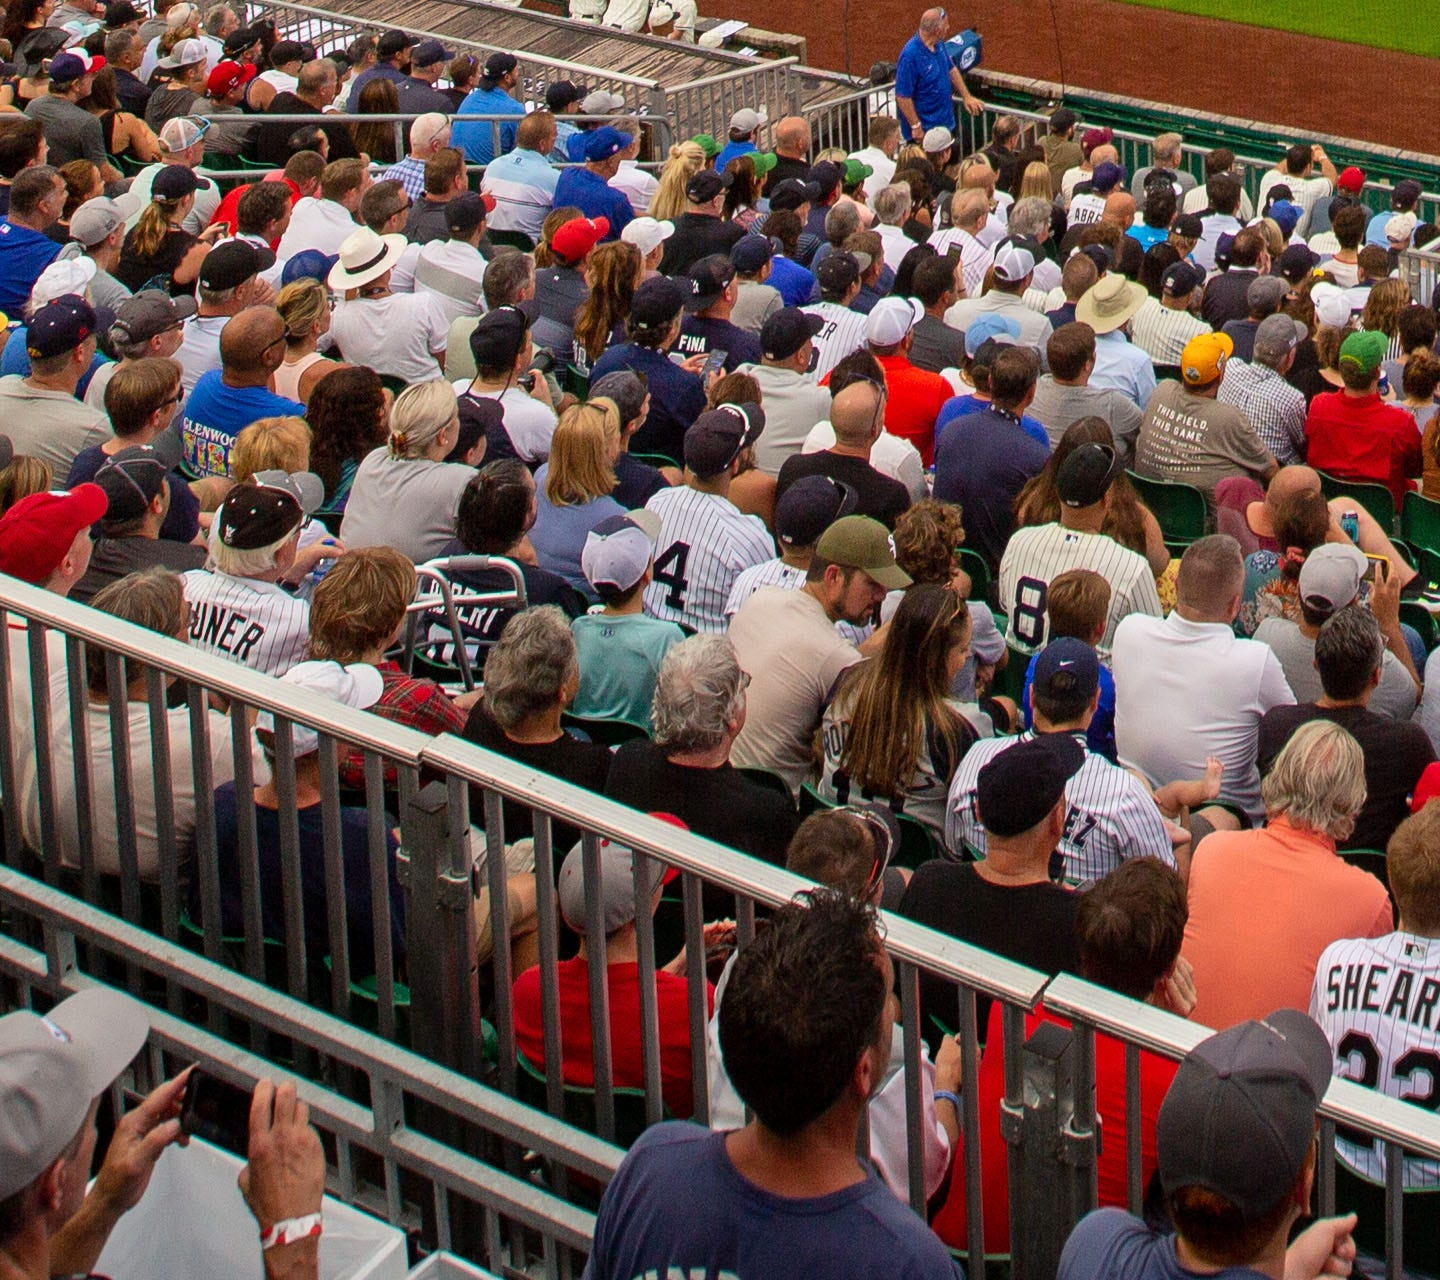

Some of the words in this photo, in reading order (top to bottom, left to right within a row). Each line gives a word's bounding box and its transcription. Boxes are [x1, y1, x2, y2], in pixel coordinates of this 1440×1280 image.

[1152, 416, 1171, 432] THIS
[1156, 403, 1177, 420] THIS
[1176, 412, 1209, 431] FIELD,
[653, 540, 691, 612] 4
[1013, 576, 1048, 648] 8
